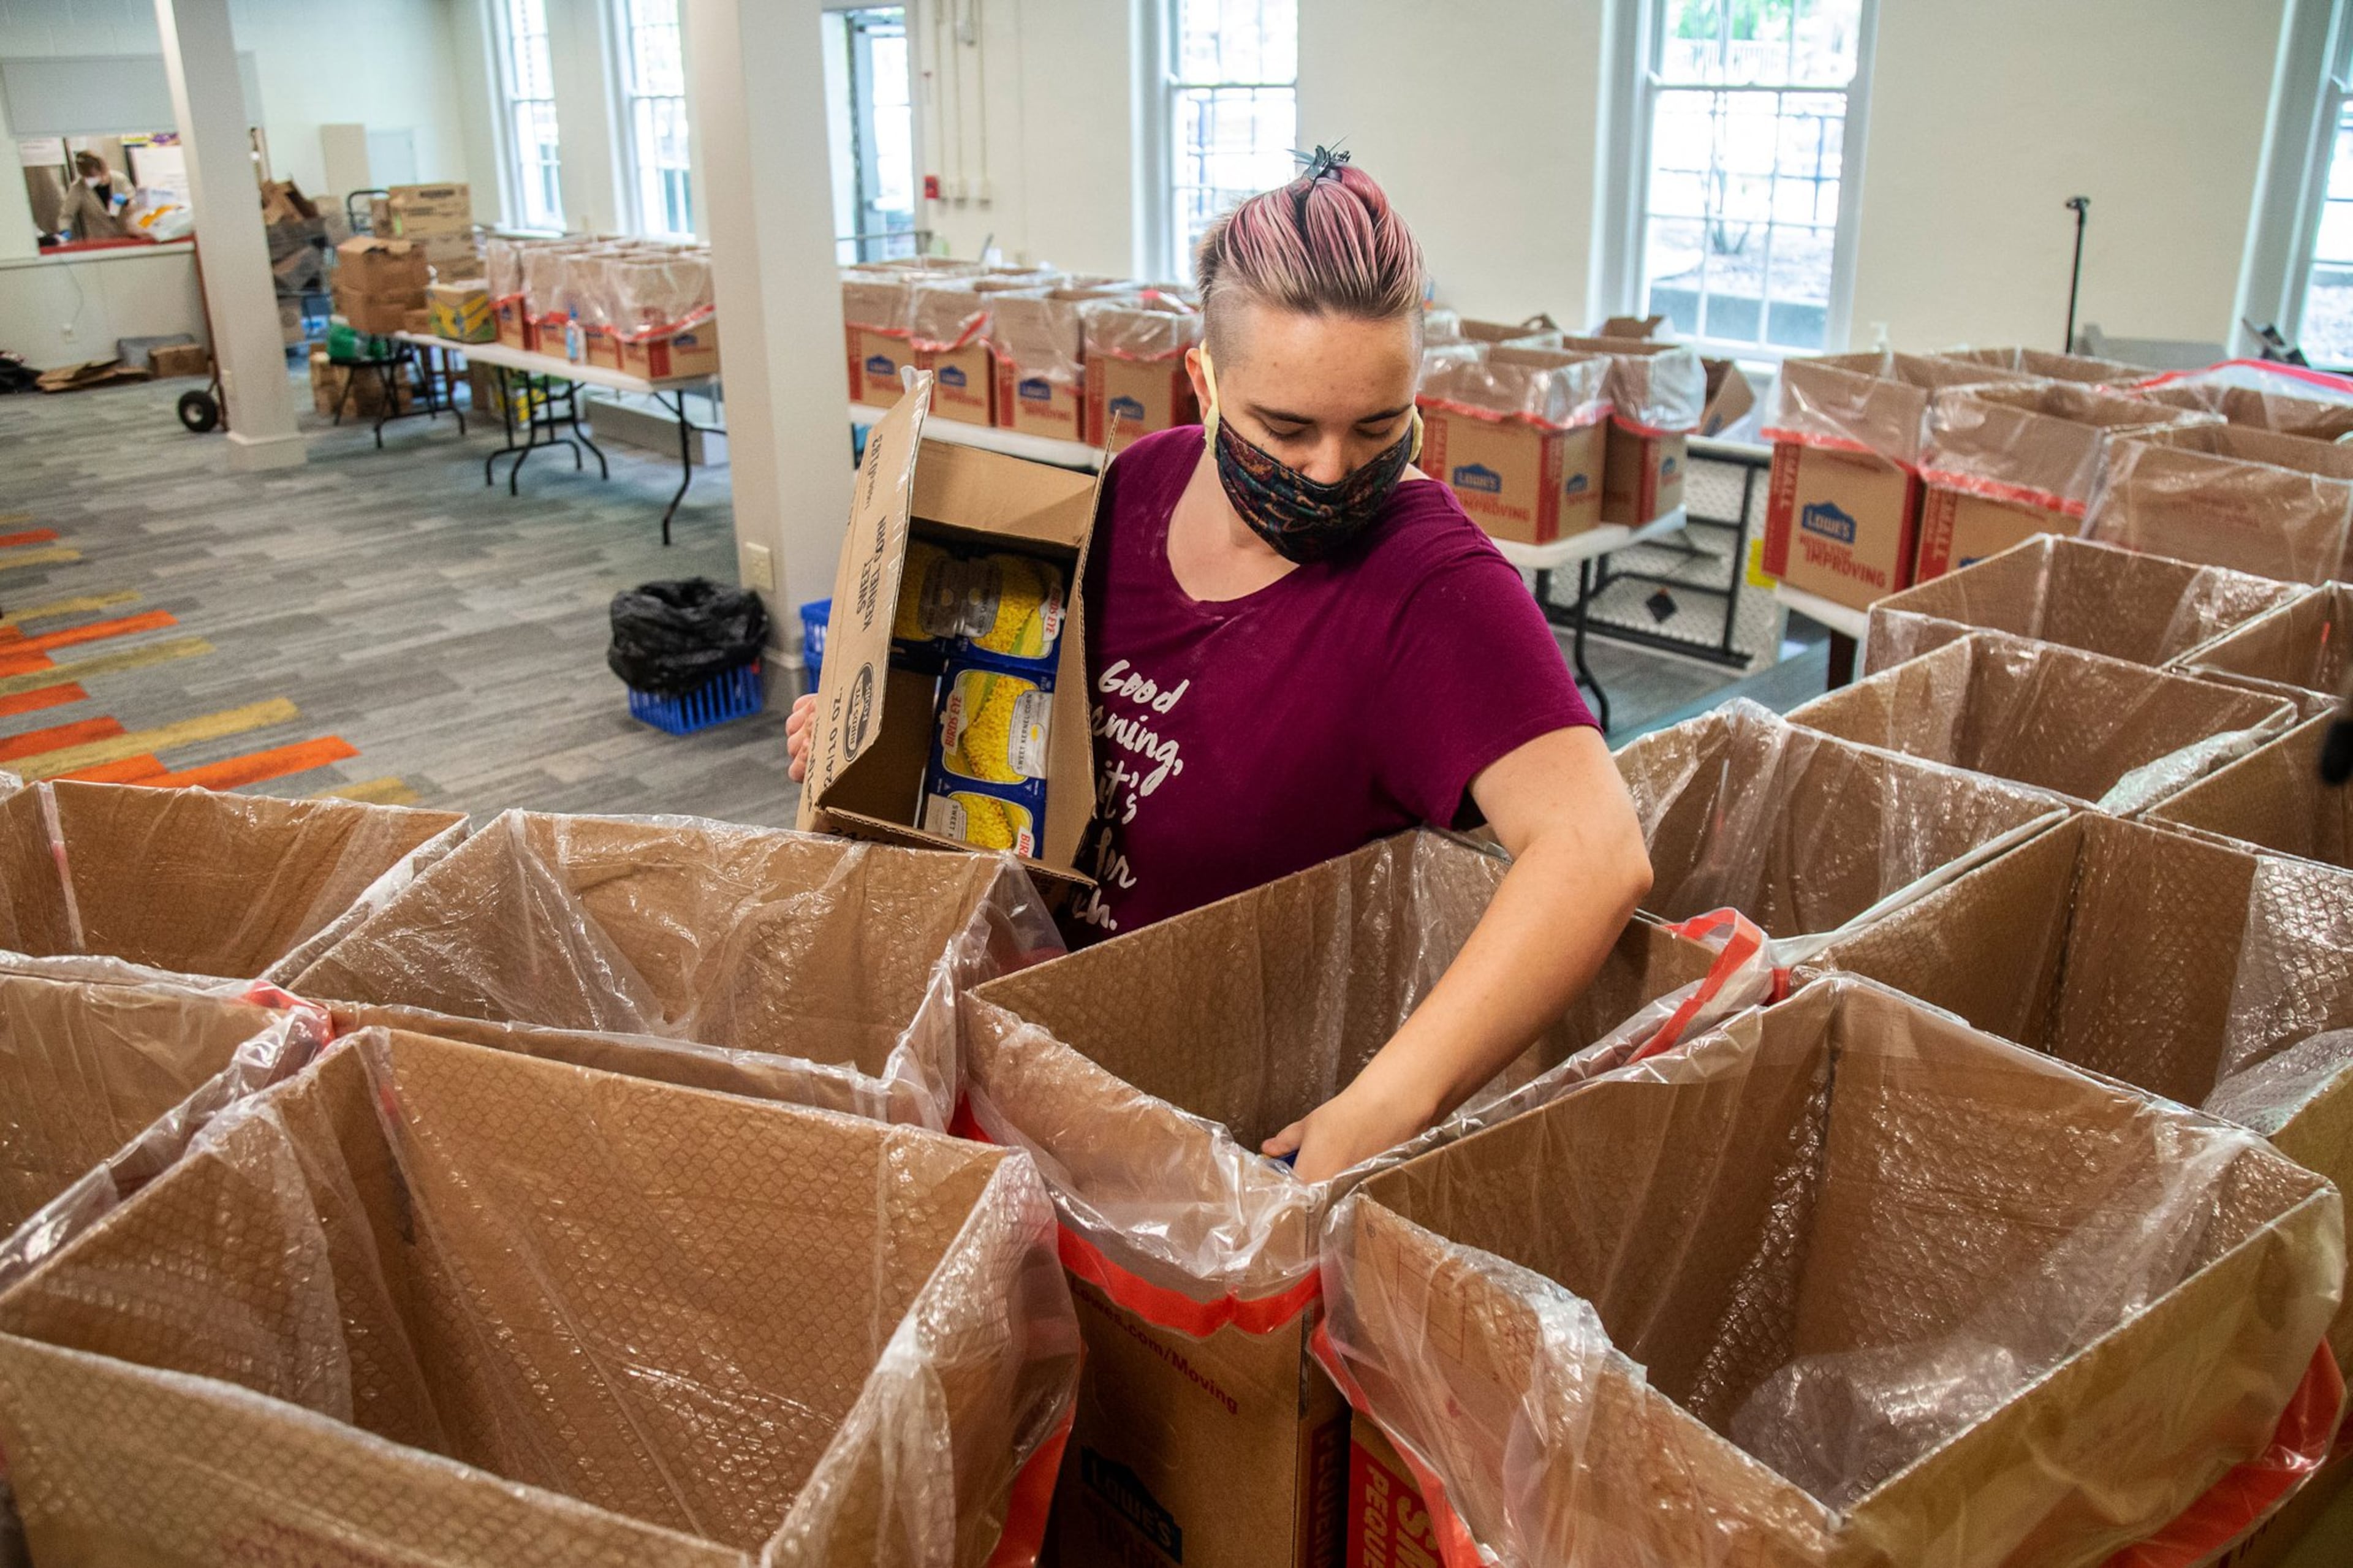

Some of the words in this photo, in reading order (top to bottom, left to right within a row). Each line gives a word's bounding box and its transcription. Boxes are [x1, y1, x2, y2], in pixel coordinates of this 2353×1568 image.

[1808, 510, 1851, 540] LOWE'S
[856, 557, 873, 615] SWEET
[862, 562, 882, 632] KERNEL
[873, 515, 887, 563] CORN
[1805, 548, 1886, 589] IMPROVING
[1048, 586, 1063, 614] BIRDS
[1045, 615, 1058, 635] EYE
[862, 681, 872, 722] FOODS
[950, 694, 962, 714] EYE
[1024, 693, 1033, 714] CORN
[1097, 659, 1191, 714] Good
[823, 728, 839, 788] 24/10
[831, 686, 844, 722] OZ.
[849, 708, 859, 746] BIRDS
[944, 716, 959, 748] BIRDS
[1021, 714, 1031, 744] KERNEL
[1017, 746, 1026, 770] SWEET
[1097, 760, 1140, 825] it's
[949, 804, 958, 831] SWEET
[1094, 825, 1138, 890] for
[1071, 1277, 1239, 1415] Lowes.com/Moving
[1090, 1458, 1173, 1548] LOWE'S
